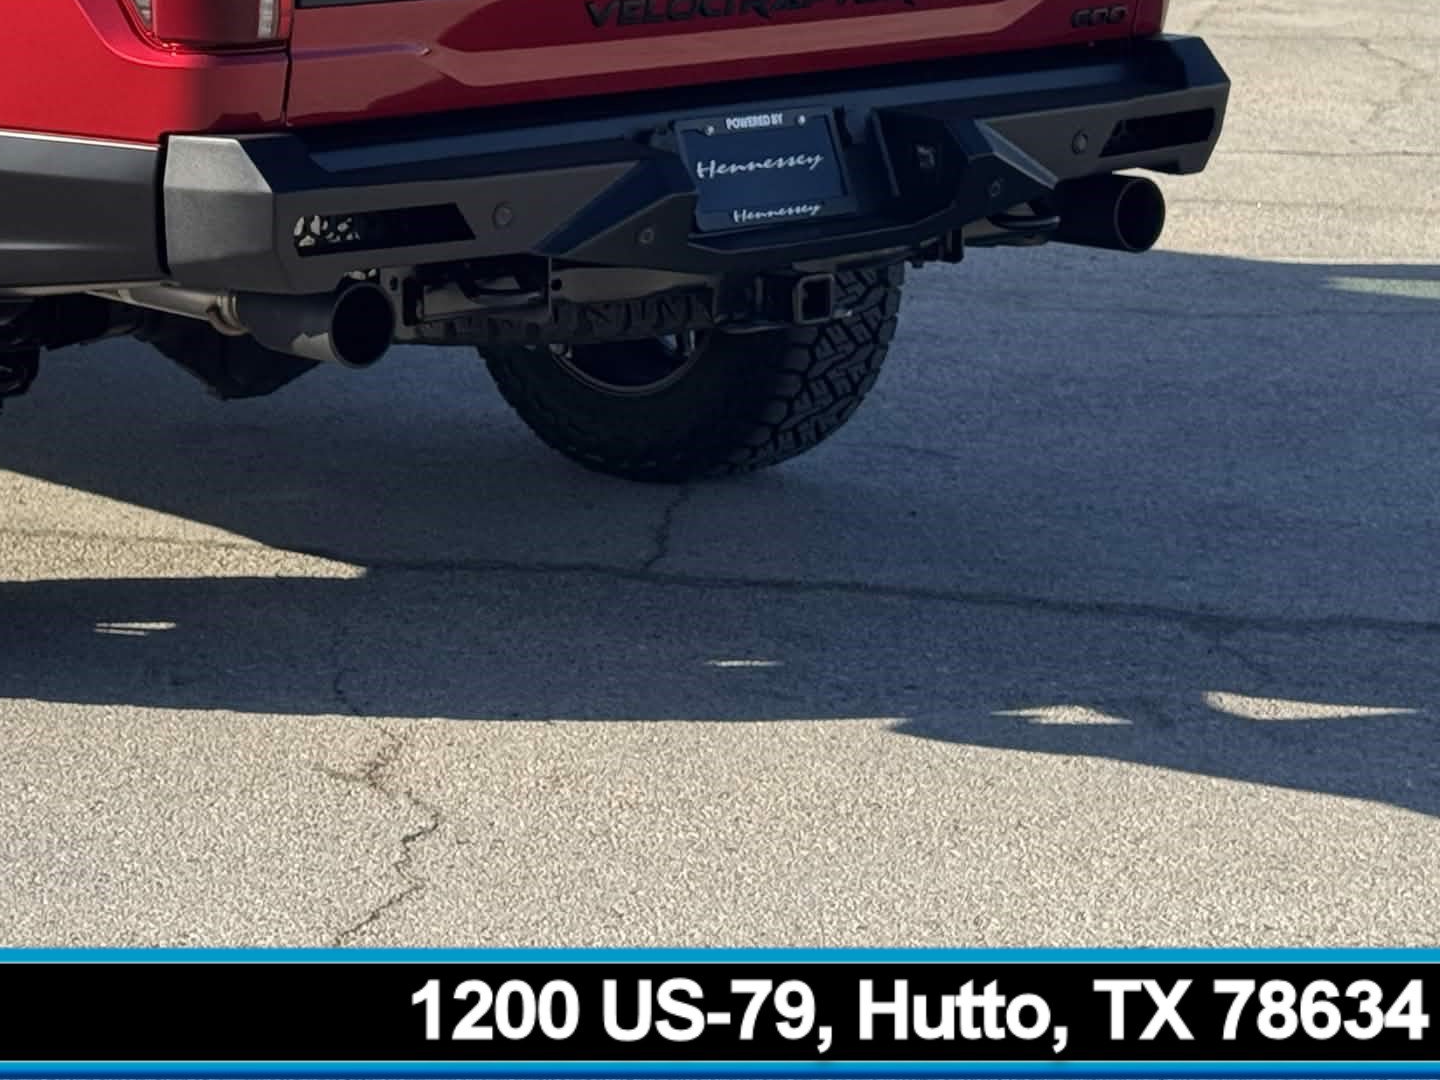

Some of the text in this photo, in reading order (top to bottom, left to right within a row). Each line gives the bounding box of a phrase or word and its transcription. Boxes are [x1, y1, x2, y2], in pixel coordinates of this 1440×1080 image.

[726, 113, 783, 130] POWERED BY
[696, 153, 824, 179] Hennessey
[733, 203, 821, 223] Hennessey
